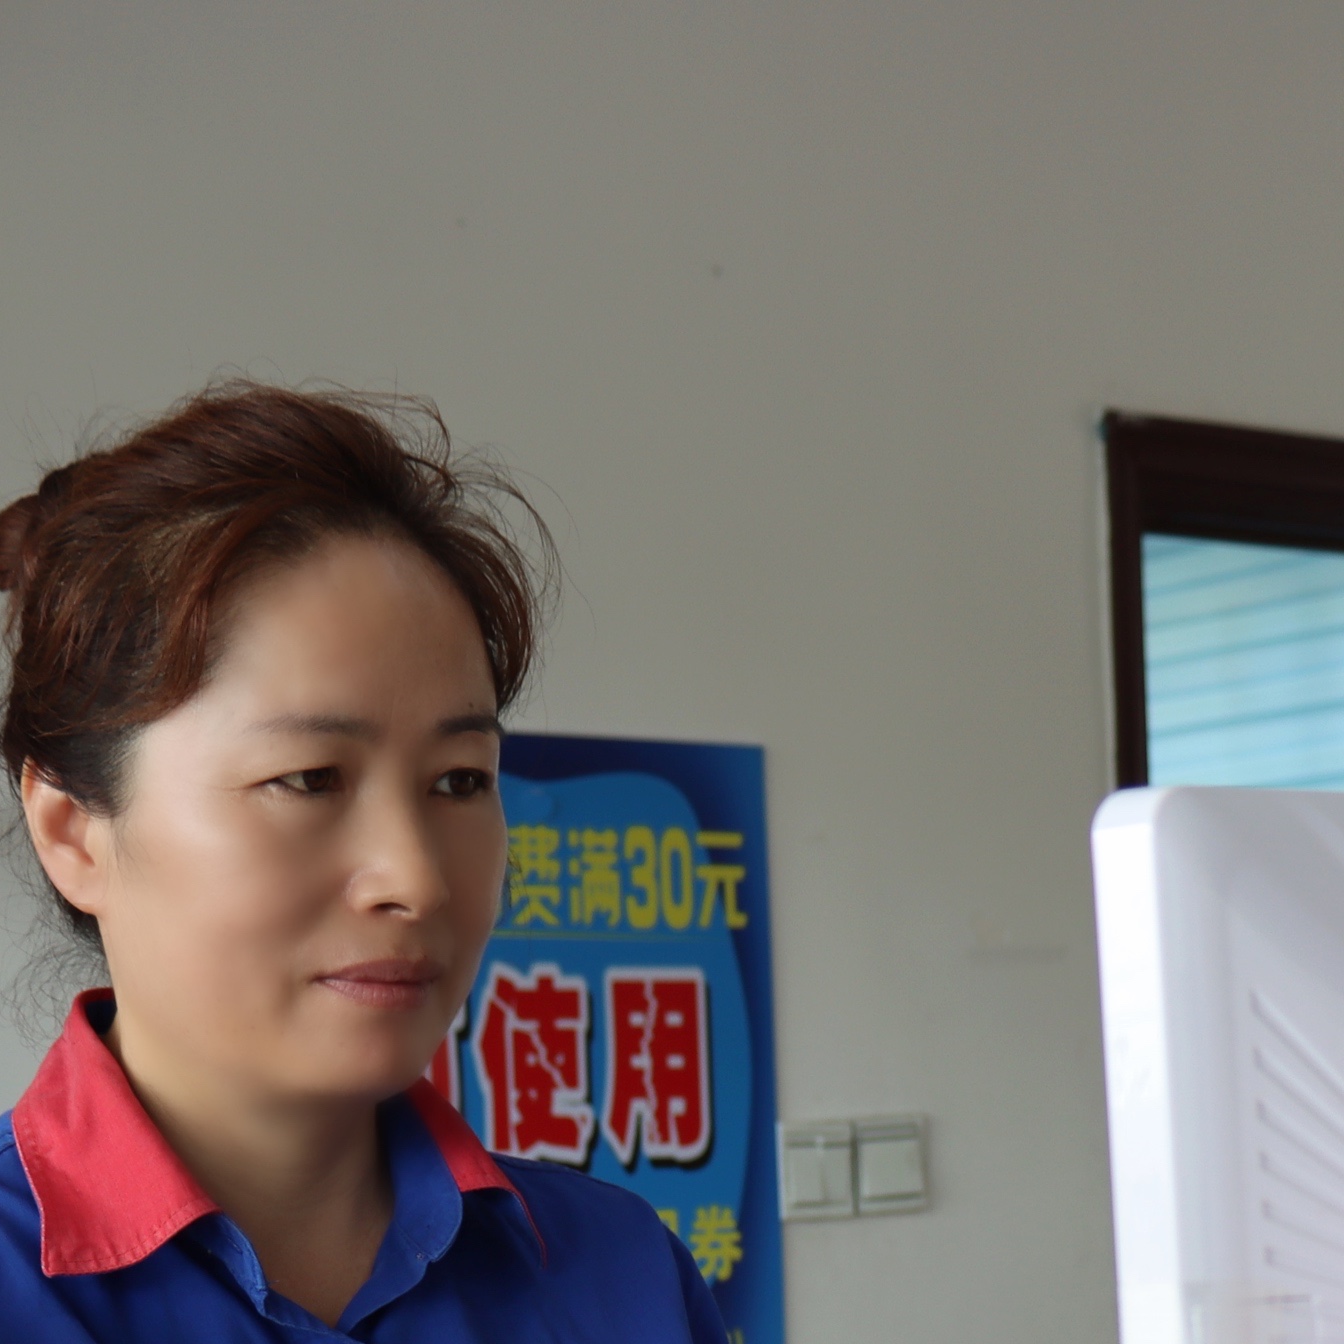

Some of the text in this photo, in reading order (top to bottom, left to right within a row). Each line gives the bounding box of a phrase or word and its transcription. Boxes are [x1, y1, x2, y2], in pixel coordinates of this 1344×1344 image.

[508, 825, 748, 931] 费满30元
[424, 962, 716, 1164] 使用
